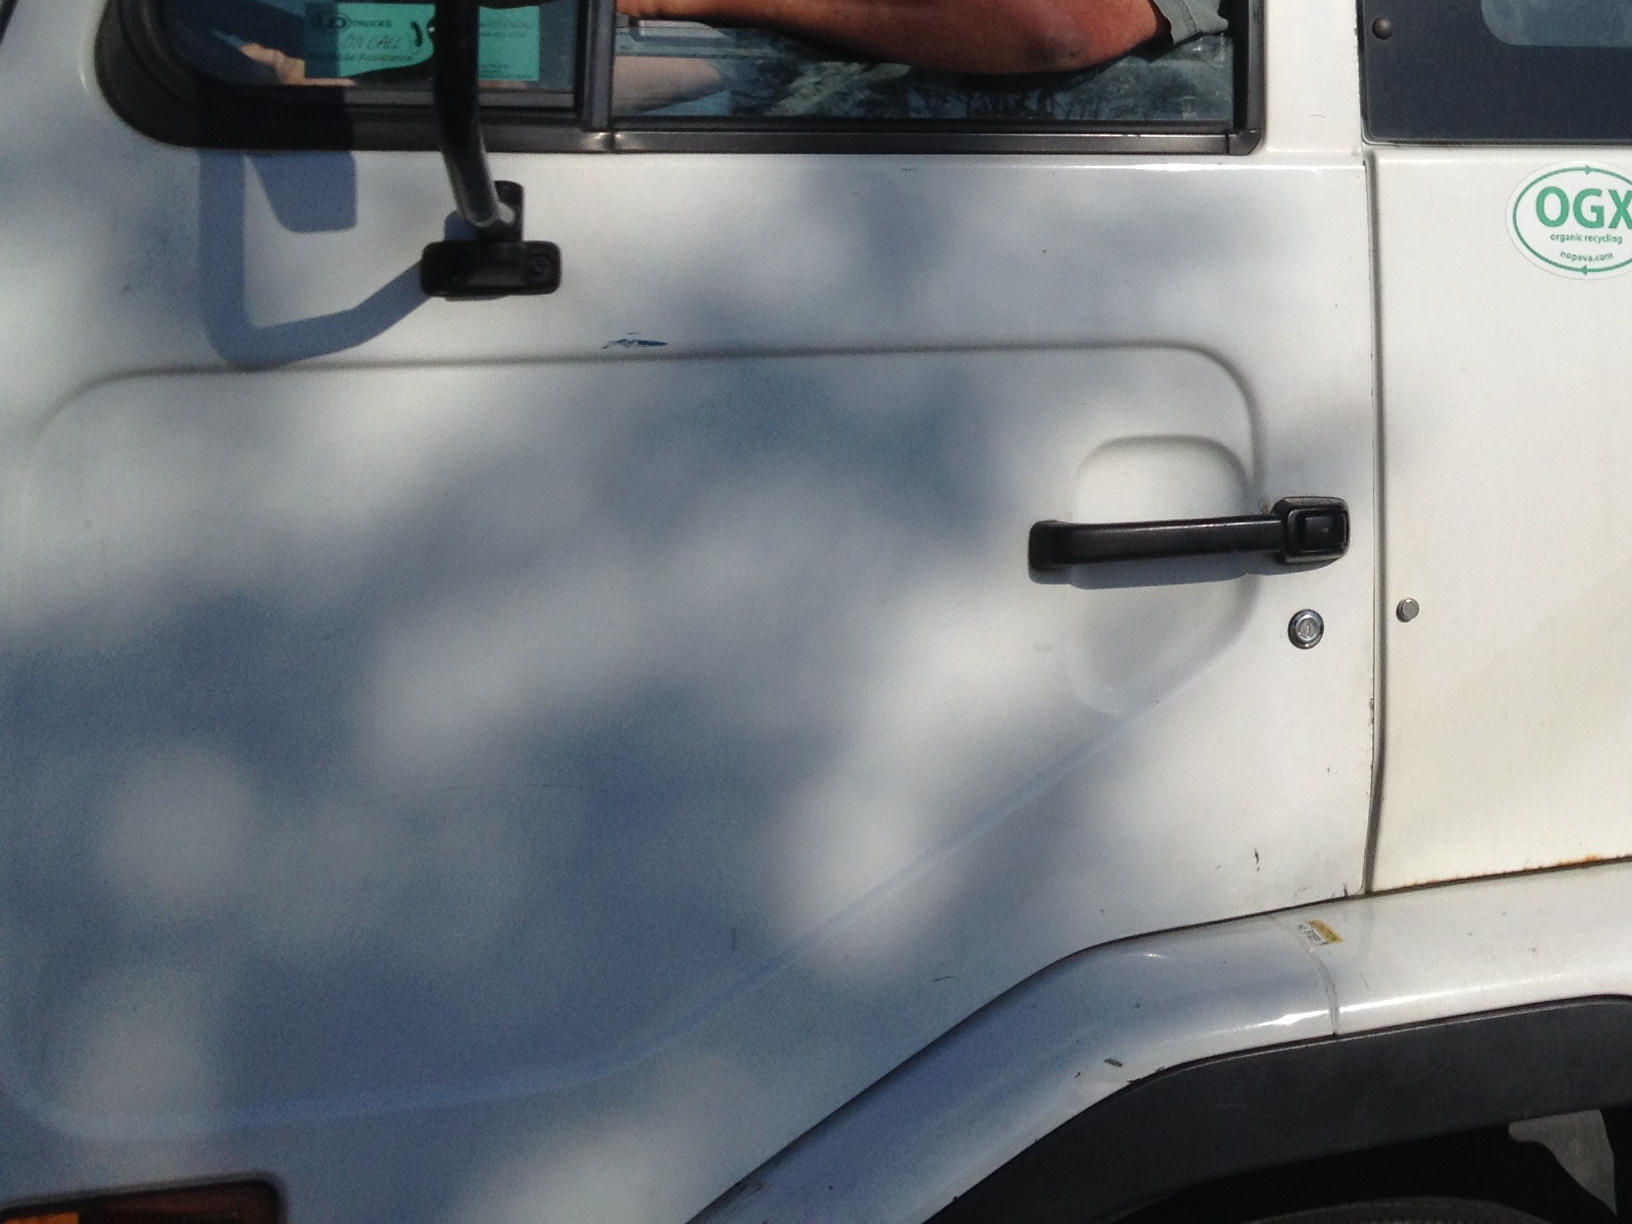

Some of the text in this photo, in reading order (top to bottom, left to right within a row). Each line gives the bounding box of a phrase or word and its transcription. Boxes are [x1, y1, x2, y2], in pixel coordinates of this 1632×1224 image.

[351, 19, 392, 28] TRUCKS
[1550, 233, 1623, 245] organic recycling
